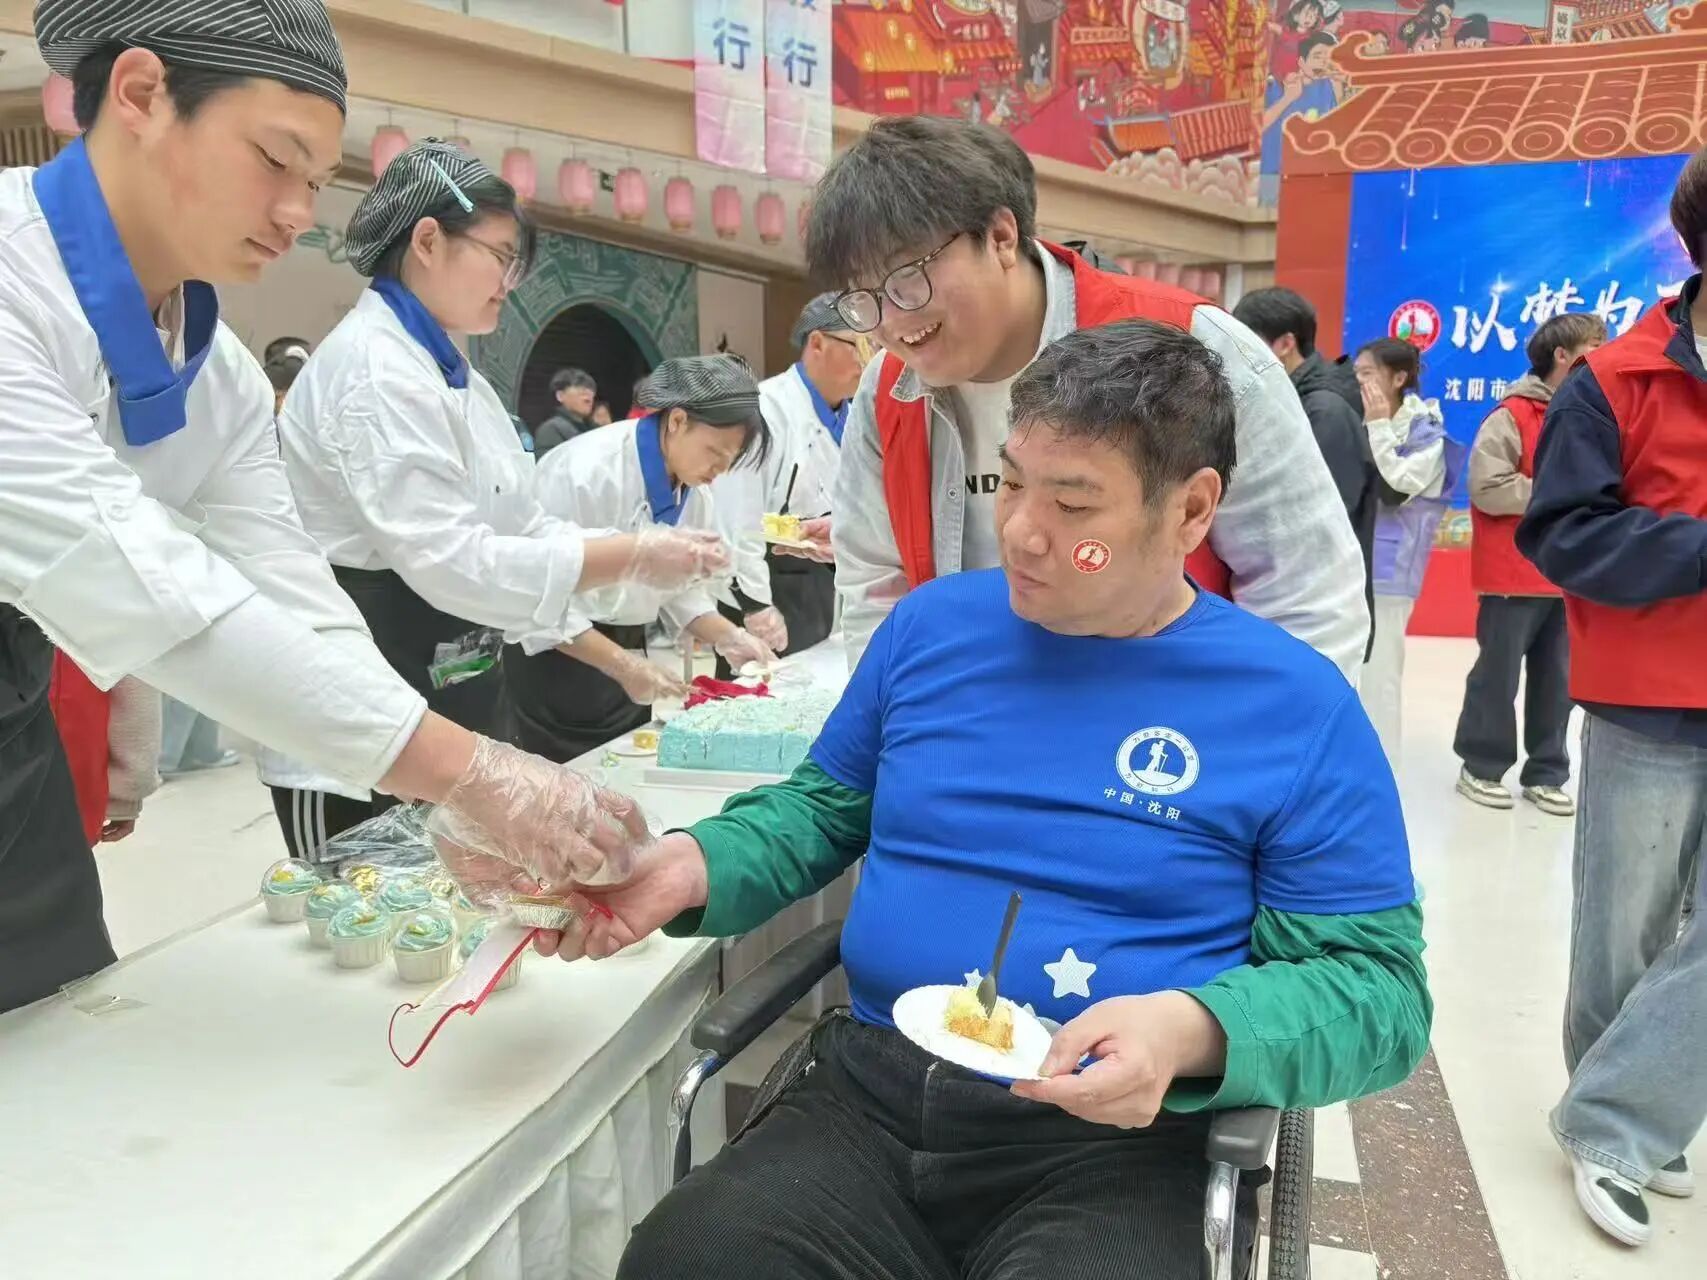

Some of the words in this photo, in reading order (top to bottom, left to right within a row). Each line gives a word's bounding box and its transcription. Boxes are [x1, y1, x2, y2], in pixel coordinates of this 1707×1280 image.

[712, 17, 751, 71] 行
[783, 0, 817, 88] 行
[1451, 277, 1686, 353] 以梦为
[1444, 377, 1508, 401] 沈阳市
